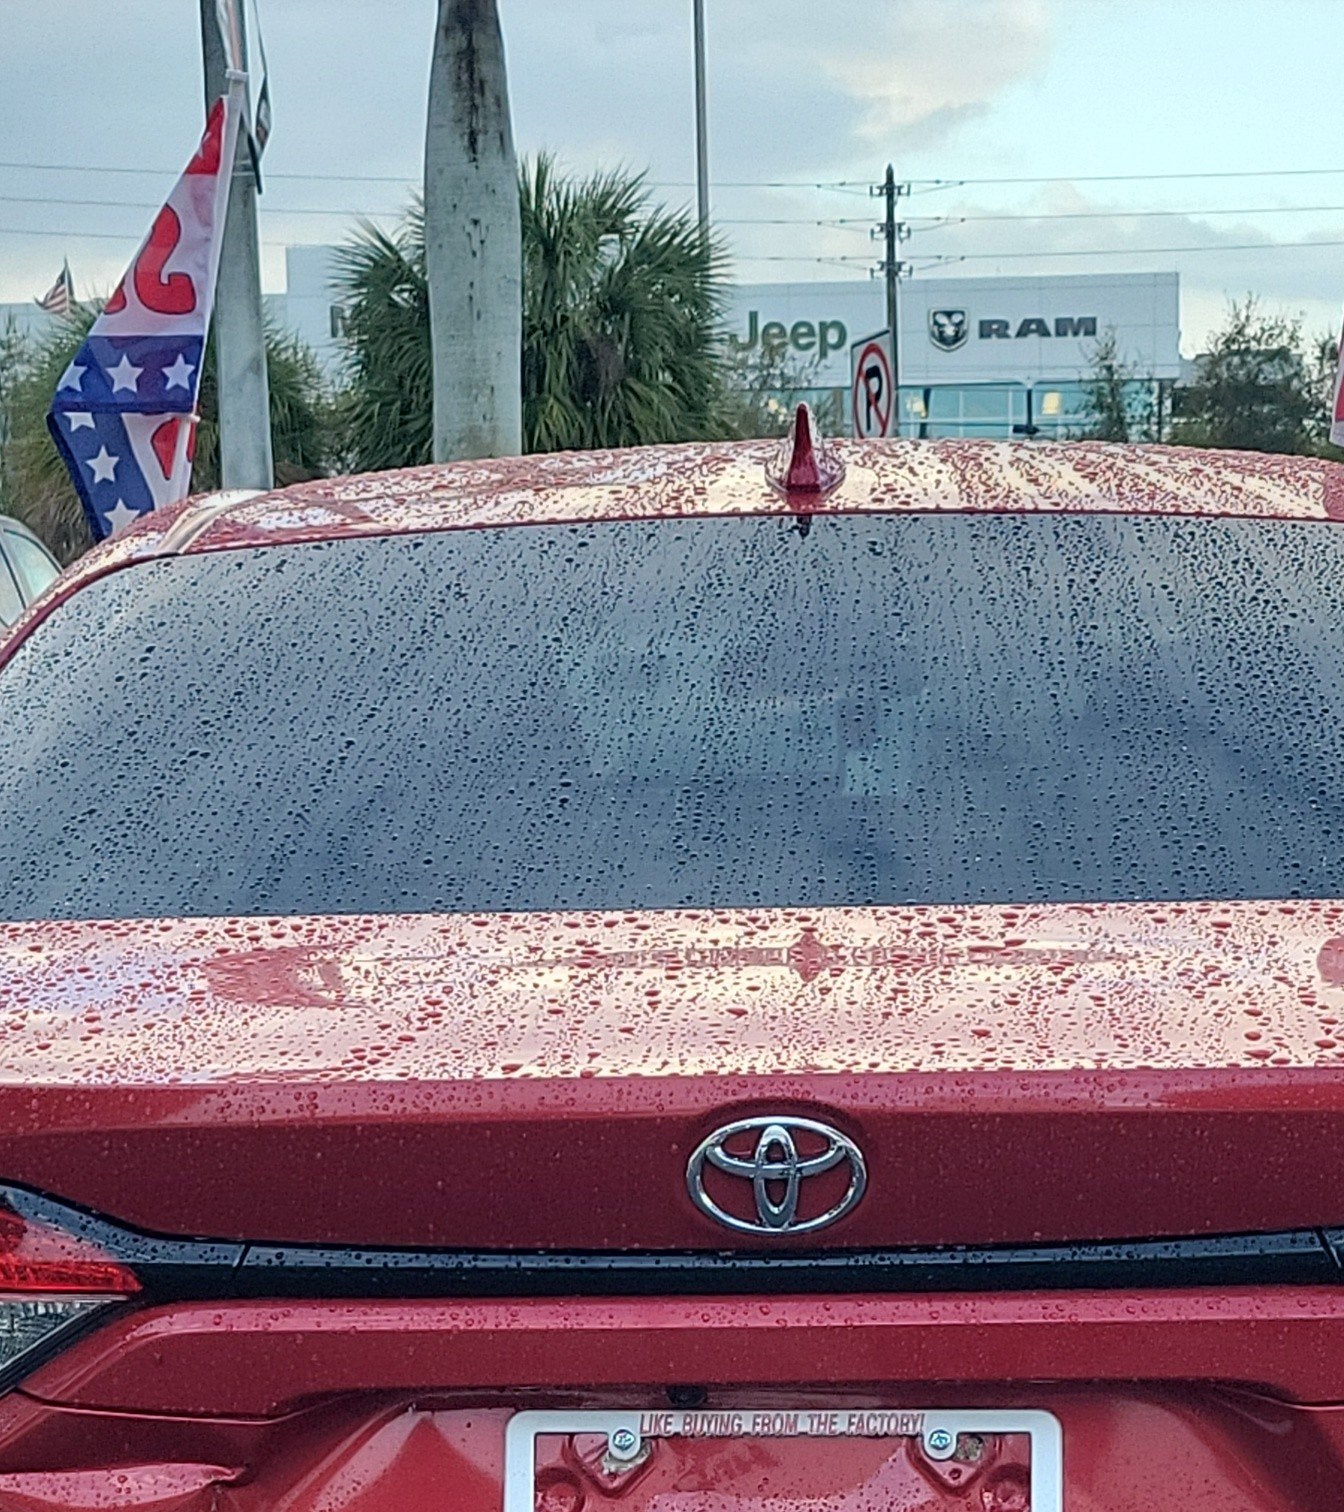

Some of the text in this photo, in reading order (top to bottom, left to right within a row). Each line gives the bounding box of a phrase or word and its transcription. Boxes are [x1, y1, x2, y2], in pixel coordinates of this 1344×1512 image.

[730, 310, 848, 361] Jeep
[978, 316, 1098, 339] RAM
[640, 1413, 674, 1435] LIKE
[682, 1413, 742, 1435] BUYING
[751, 1413, 799, 1435] FROM
[807, 1413, 839, 1435] THE
